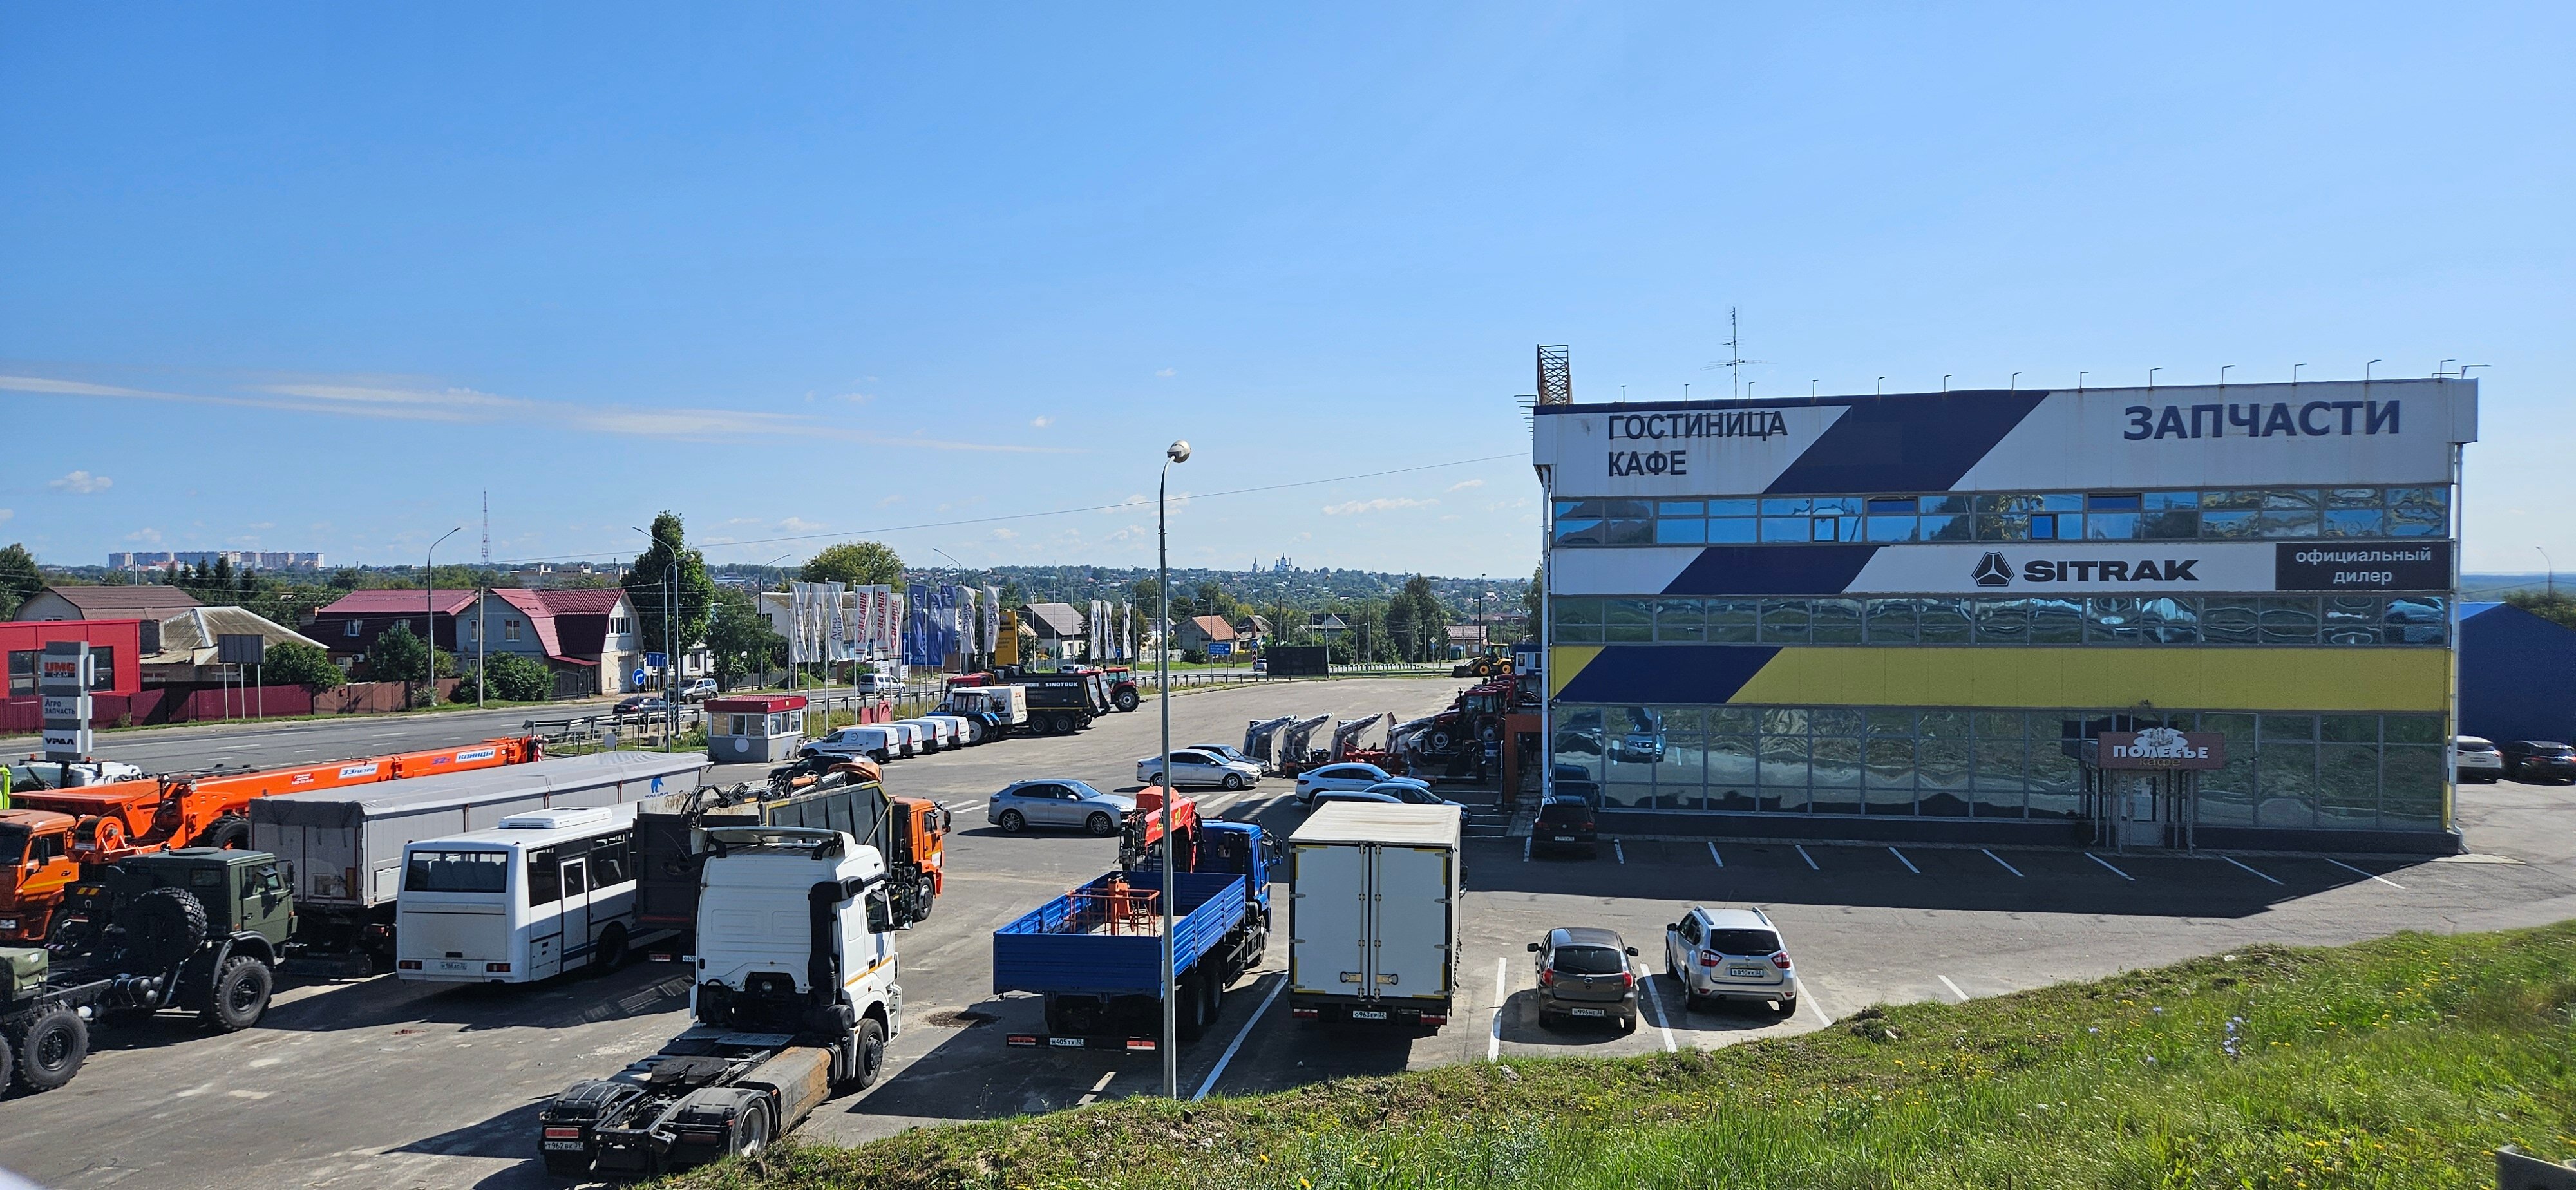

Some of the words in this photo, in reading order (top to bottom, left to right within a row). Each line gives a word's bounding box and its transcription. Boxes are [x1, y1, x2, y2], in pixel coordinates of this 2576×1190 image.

[1609, 411, 1788, 441] ГОСТИНИЦА
[2124, 400, 2400, 440] ЗАПЧАСТИ
[1609, 450, 1687, 477] КАФЕ
[2295, 547, 2431, 565] официальный
[2023, 560, 2199, 582] SITRAK
[2333, 571, 2392, 585] дилер
[858, 592, 867, 630] BELARUS
[44, 662, 75, 672] UMG
[458, 750, 493, 760] КЛИНЦЫ
[2113, 745, 2209, 759] ПОЛЕСЬЕ
[2139, 759, 2181, 768] кафе
